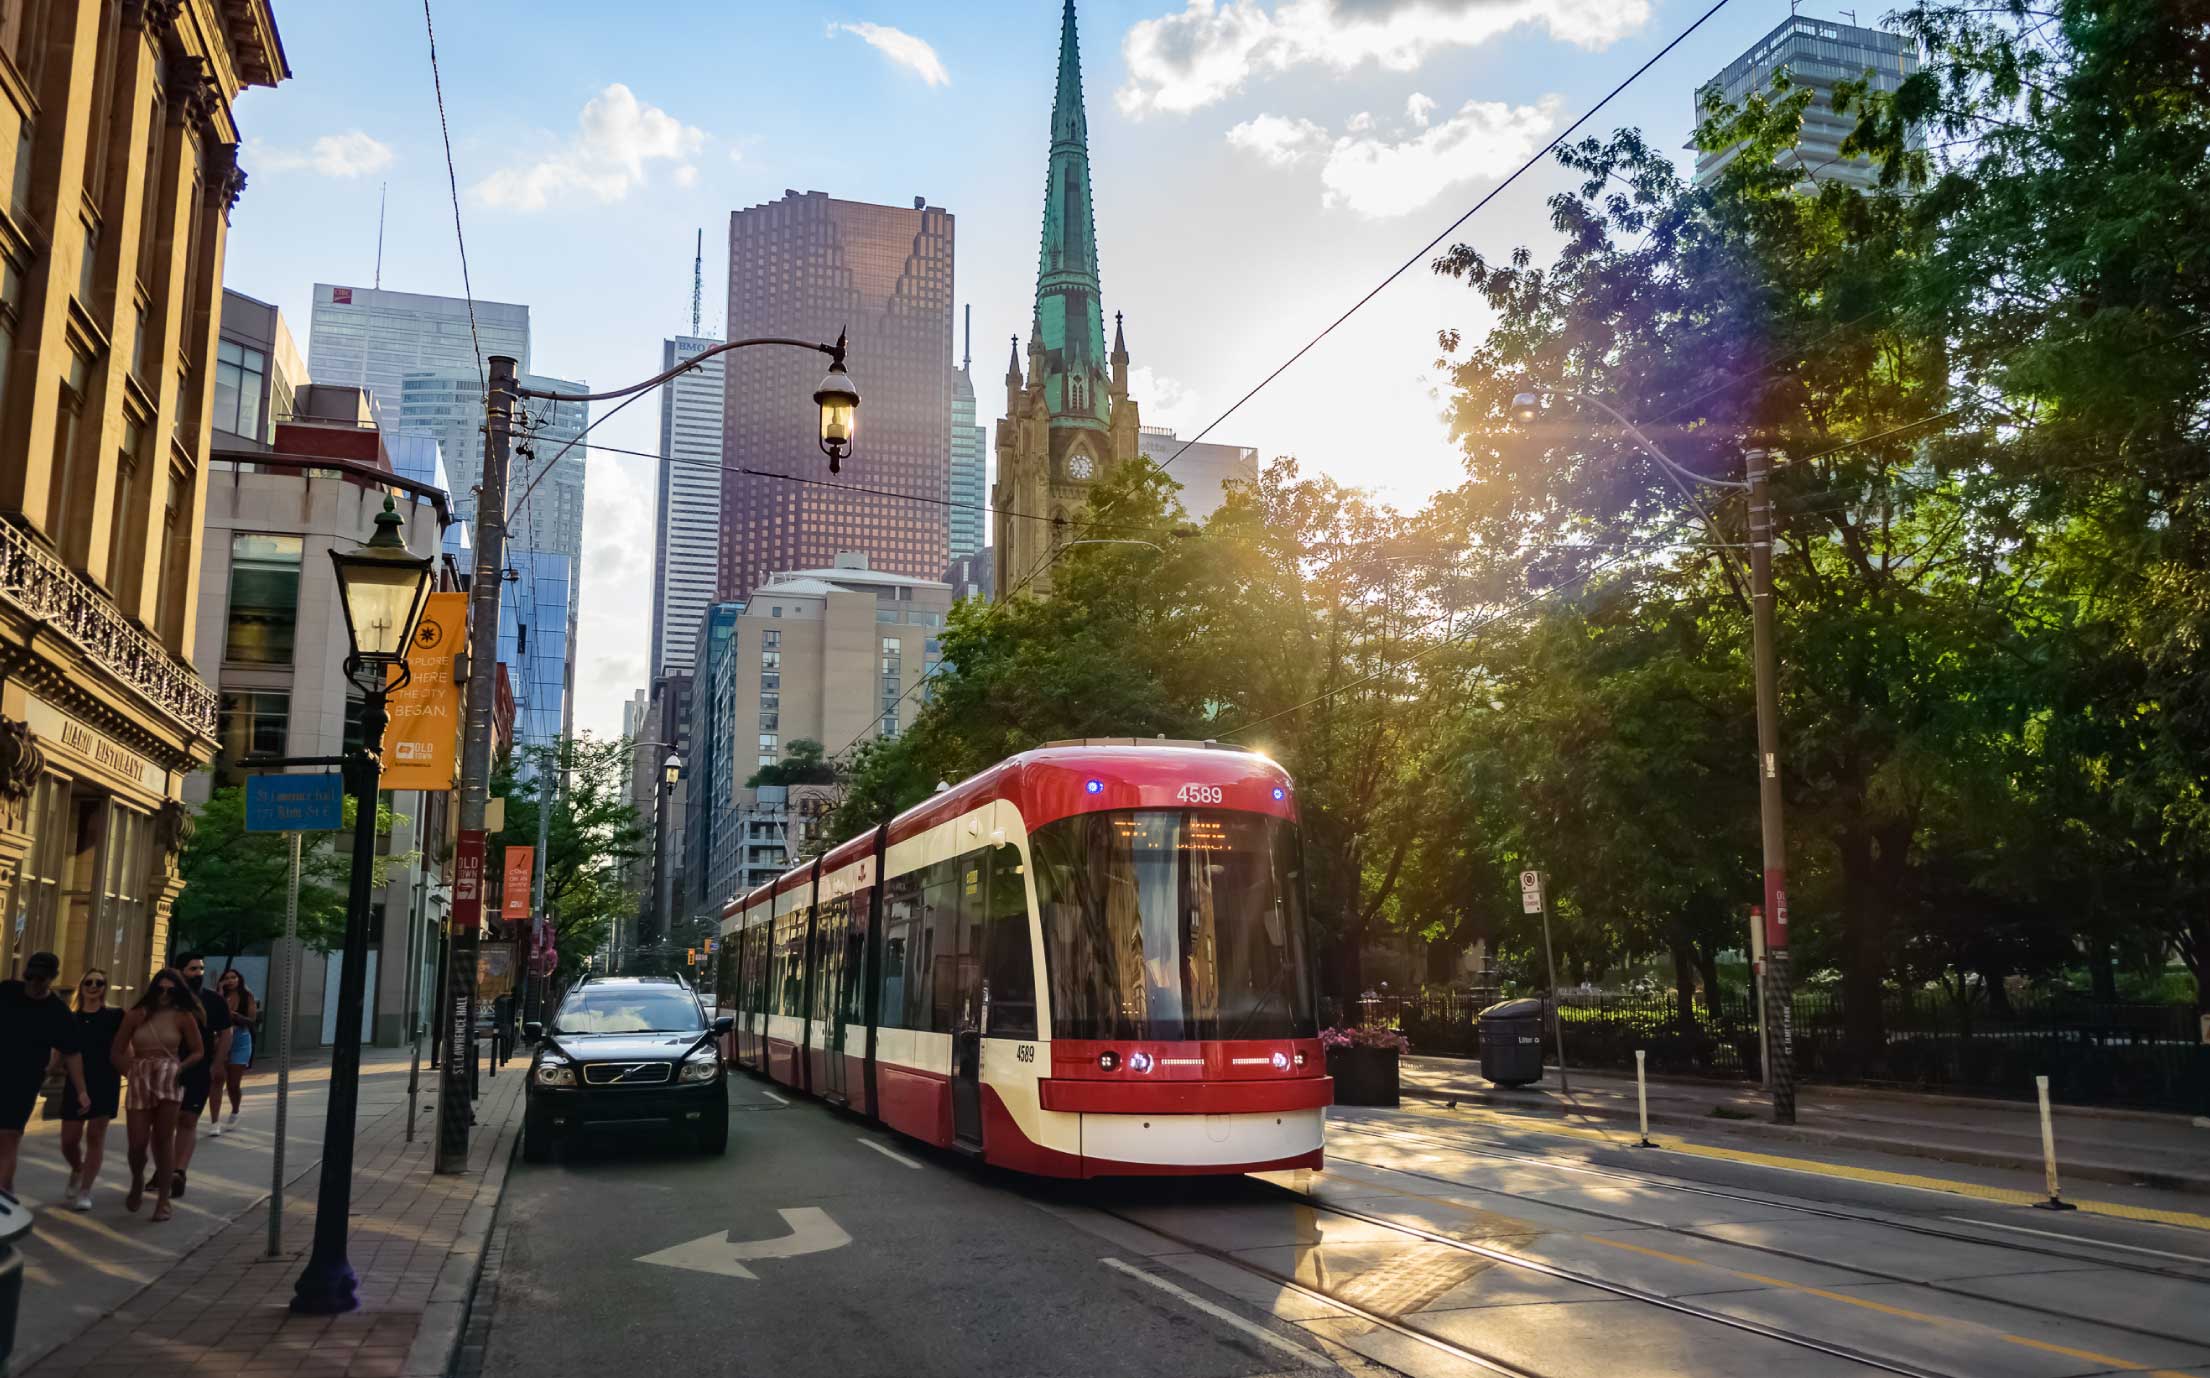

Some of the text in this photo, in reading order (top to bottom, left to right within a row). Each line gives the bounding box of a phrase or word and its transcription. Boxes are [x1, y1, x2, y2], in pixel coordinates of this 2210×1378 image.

[679, 342, 705, 352] BMO
[413, 671, 449, 684] HERE
[414, 742, 433, 753] OLD
[1176, 786, 1222, 803] 4589
[456, 996, 468, 1017] HALL
[453, 1017, 467, 1061] LAWRENCE
[1016, 1044, 1035, 1063] 4589
